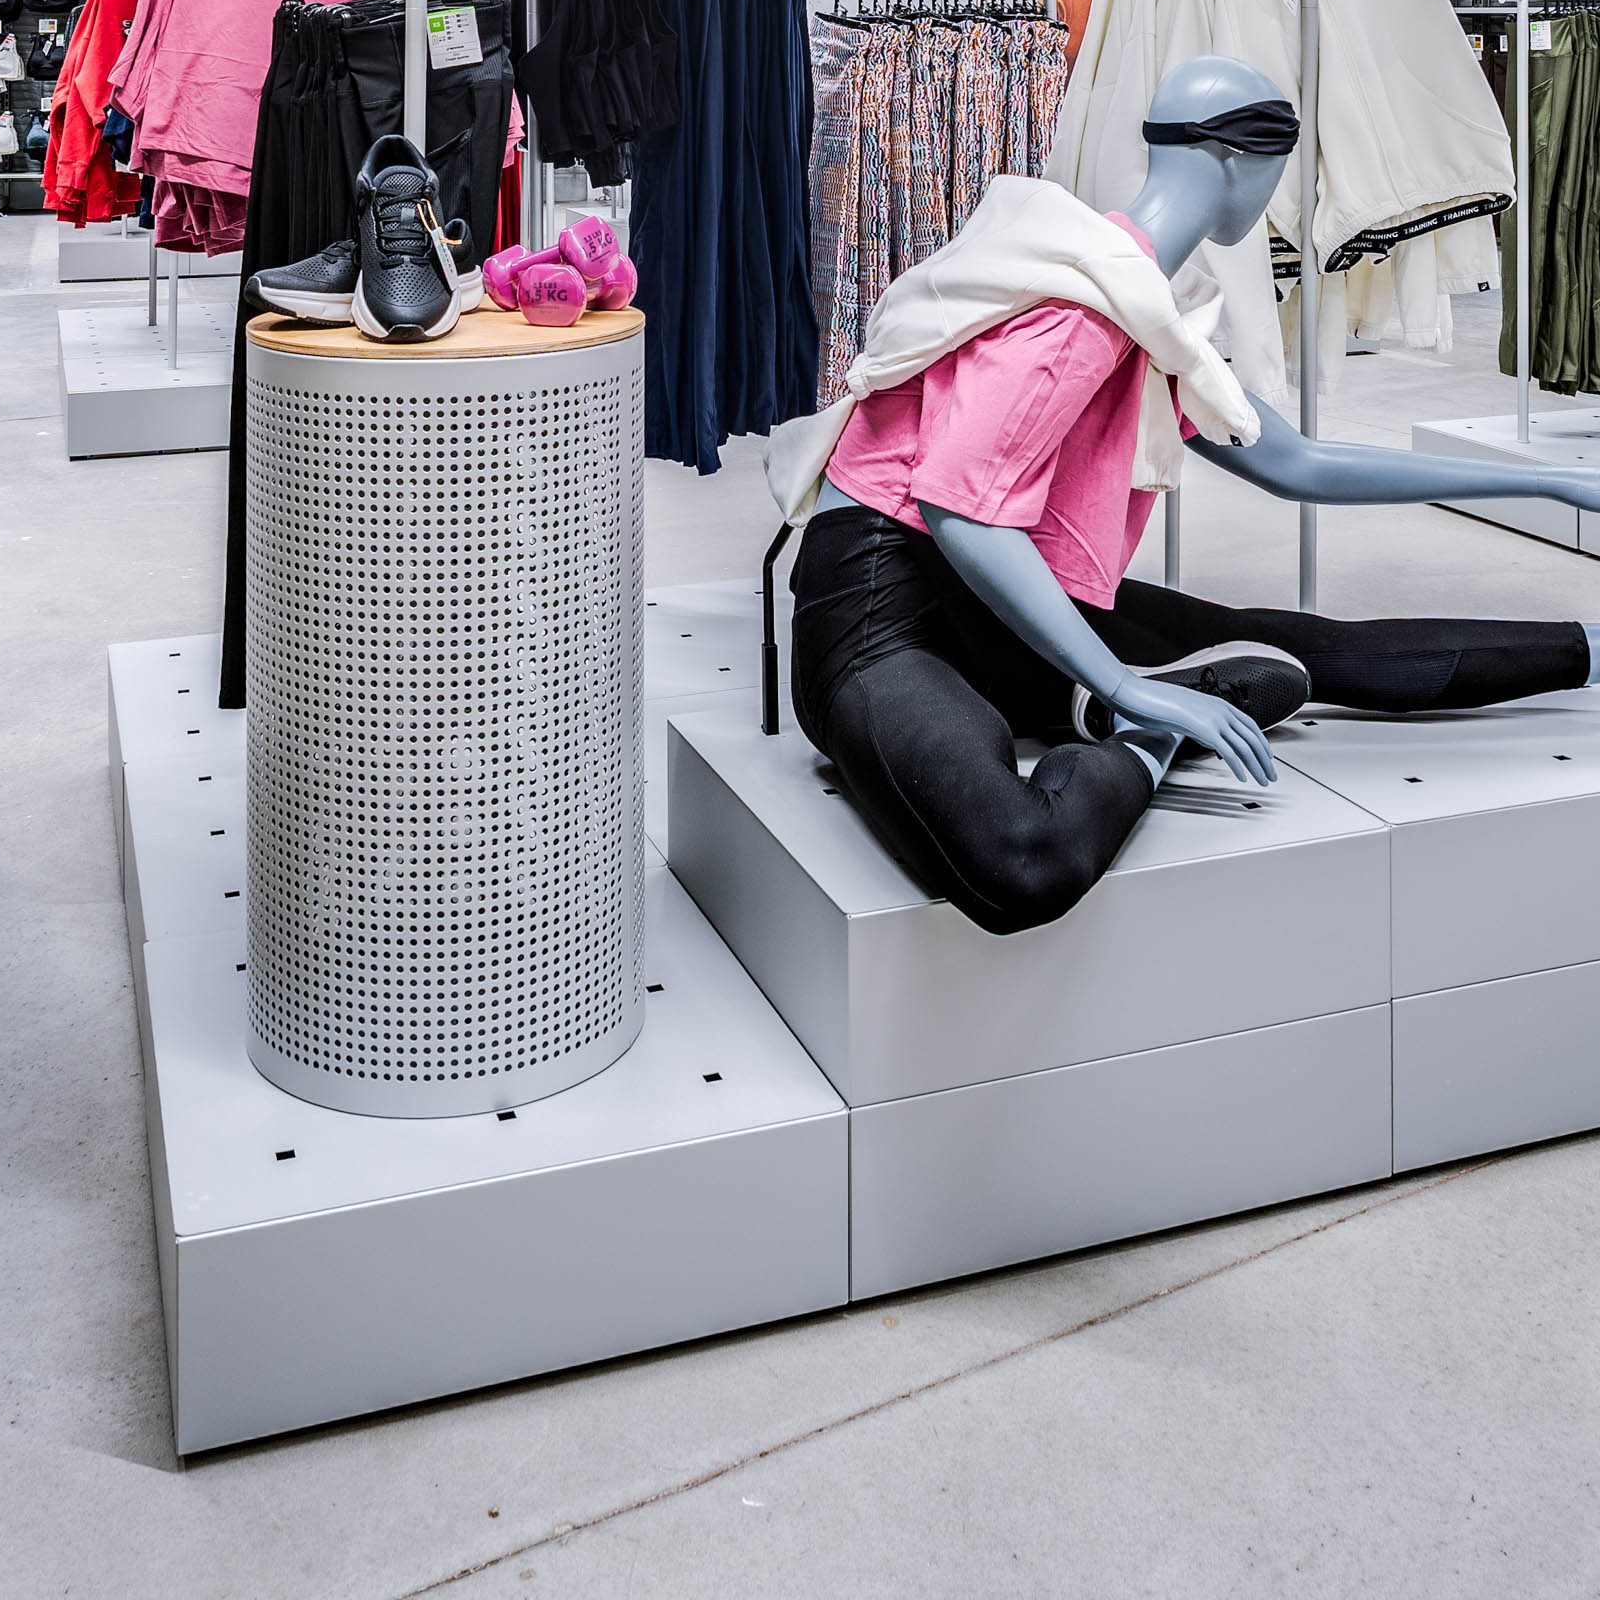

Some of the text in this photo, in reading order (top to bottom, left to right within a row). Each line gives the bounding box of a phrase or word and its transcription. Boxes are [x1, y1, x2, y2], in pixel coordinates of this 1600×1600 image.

[1443, 206, 1480, 222] TRAINING
[1404, 218, 1439, 235] TRAINING
[1361, 231, 1399, 241] TRAINING
[546, 289, 569, 302] KG
